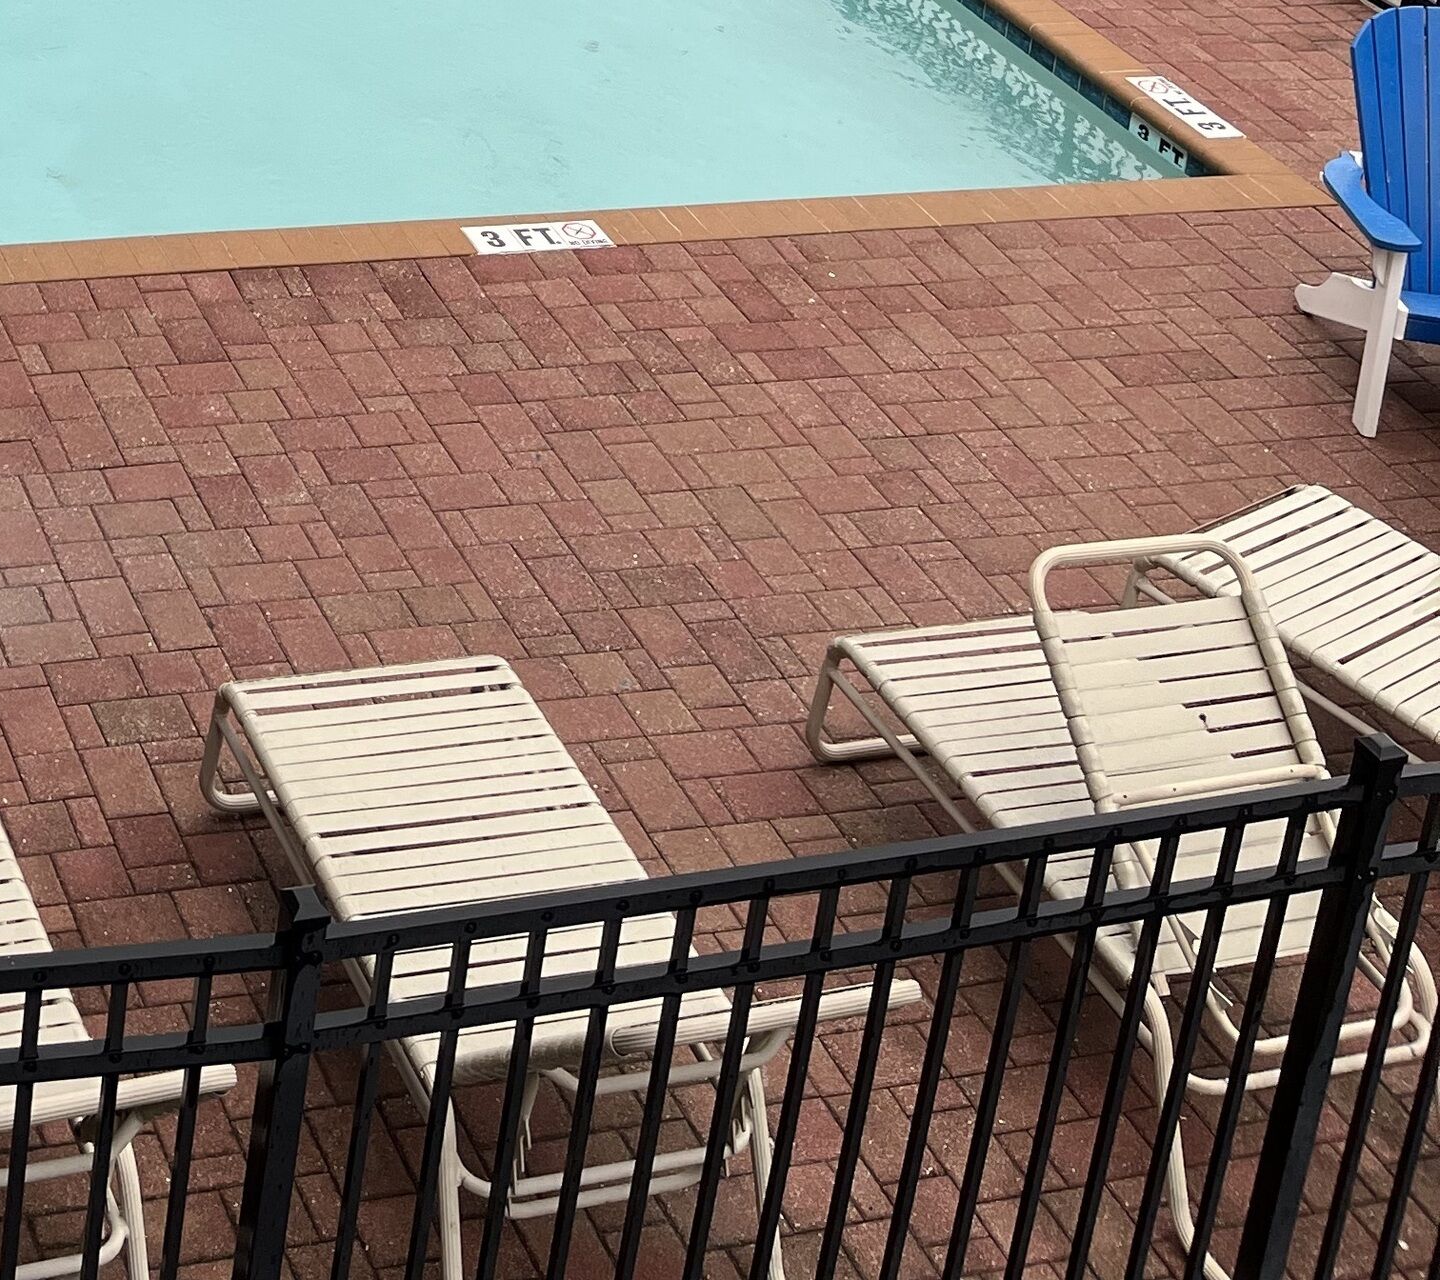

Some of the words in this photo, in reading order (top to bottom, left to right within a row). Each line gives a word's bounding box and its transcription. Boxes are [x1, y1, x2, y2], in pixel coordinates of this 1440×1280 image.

[1137, 124, 1150, 142] 3
[1197, 121, 1227, 132] 3
[480, 230, 506, 248] 3
[513, 227, 562, 247] FT.
